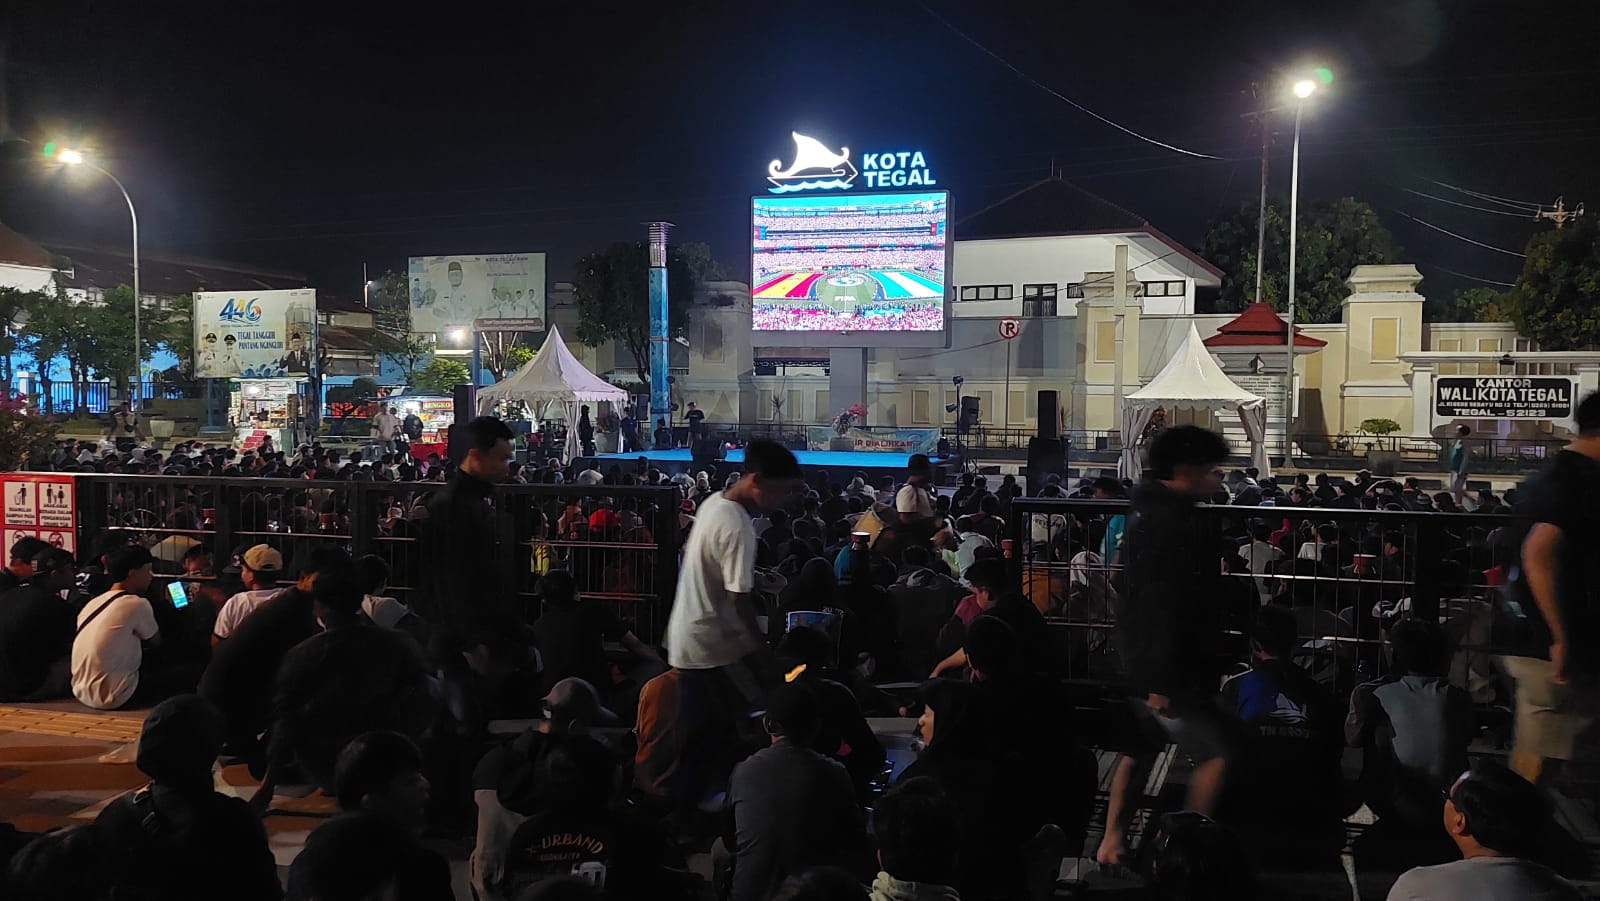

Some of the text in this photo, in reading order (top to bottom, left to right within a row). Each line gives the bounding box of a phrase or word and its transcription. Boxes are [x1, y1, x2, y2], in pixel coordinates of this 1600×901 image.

[863, 151, 926, 170] KOTA
[863, 169, 937, 188] TEGAL
[219, 297, 262, 322] 446
[1475, 378, 1532, 388] KANTOR
[1440, 387, 1569, 402] WALIKOTA TEGAL
[1453, 408, 1496, 416] TEGAL
[1506, 409, 1546, 417] 52123
[541, 833, 605, 854] URBAND
